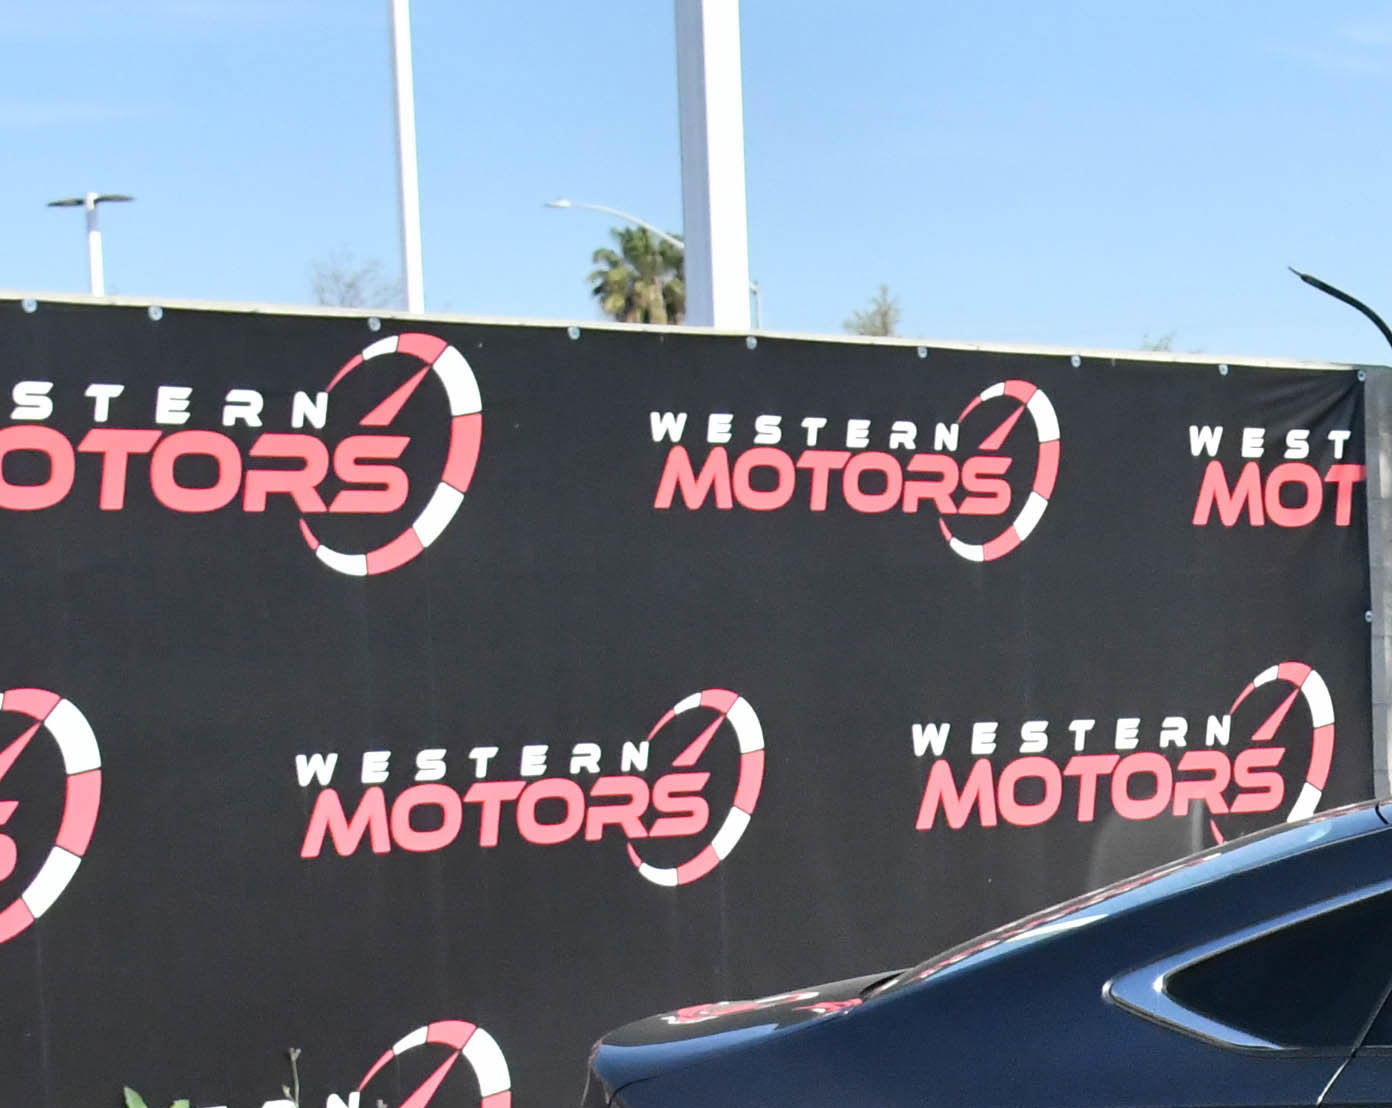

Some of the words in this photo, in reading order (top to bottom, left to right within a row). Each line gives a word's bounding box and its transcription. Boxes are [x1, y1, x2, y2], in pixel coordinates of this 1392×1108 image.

[649, 410, 960, 453] WESTERN
[1188, 424, 1352, 460] WEST
[653, 445, 1013, 517] MOTORS
[1191, 460, 1364, 528] MOT
[294, 739, 651, 788] WESTERN
[908, 713, 1232, 758] WESTERN
[299, 771, 712, 859] MOTORS
[914, 747, 1287, 832] MOTORS
